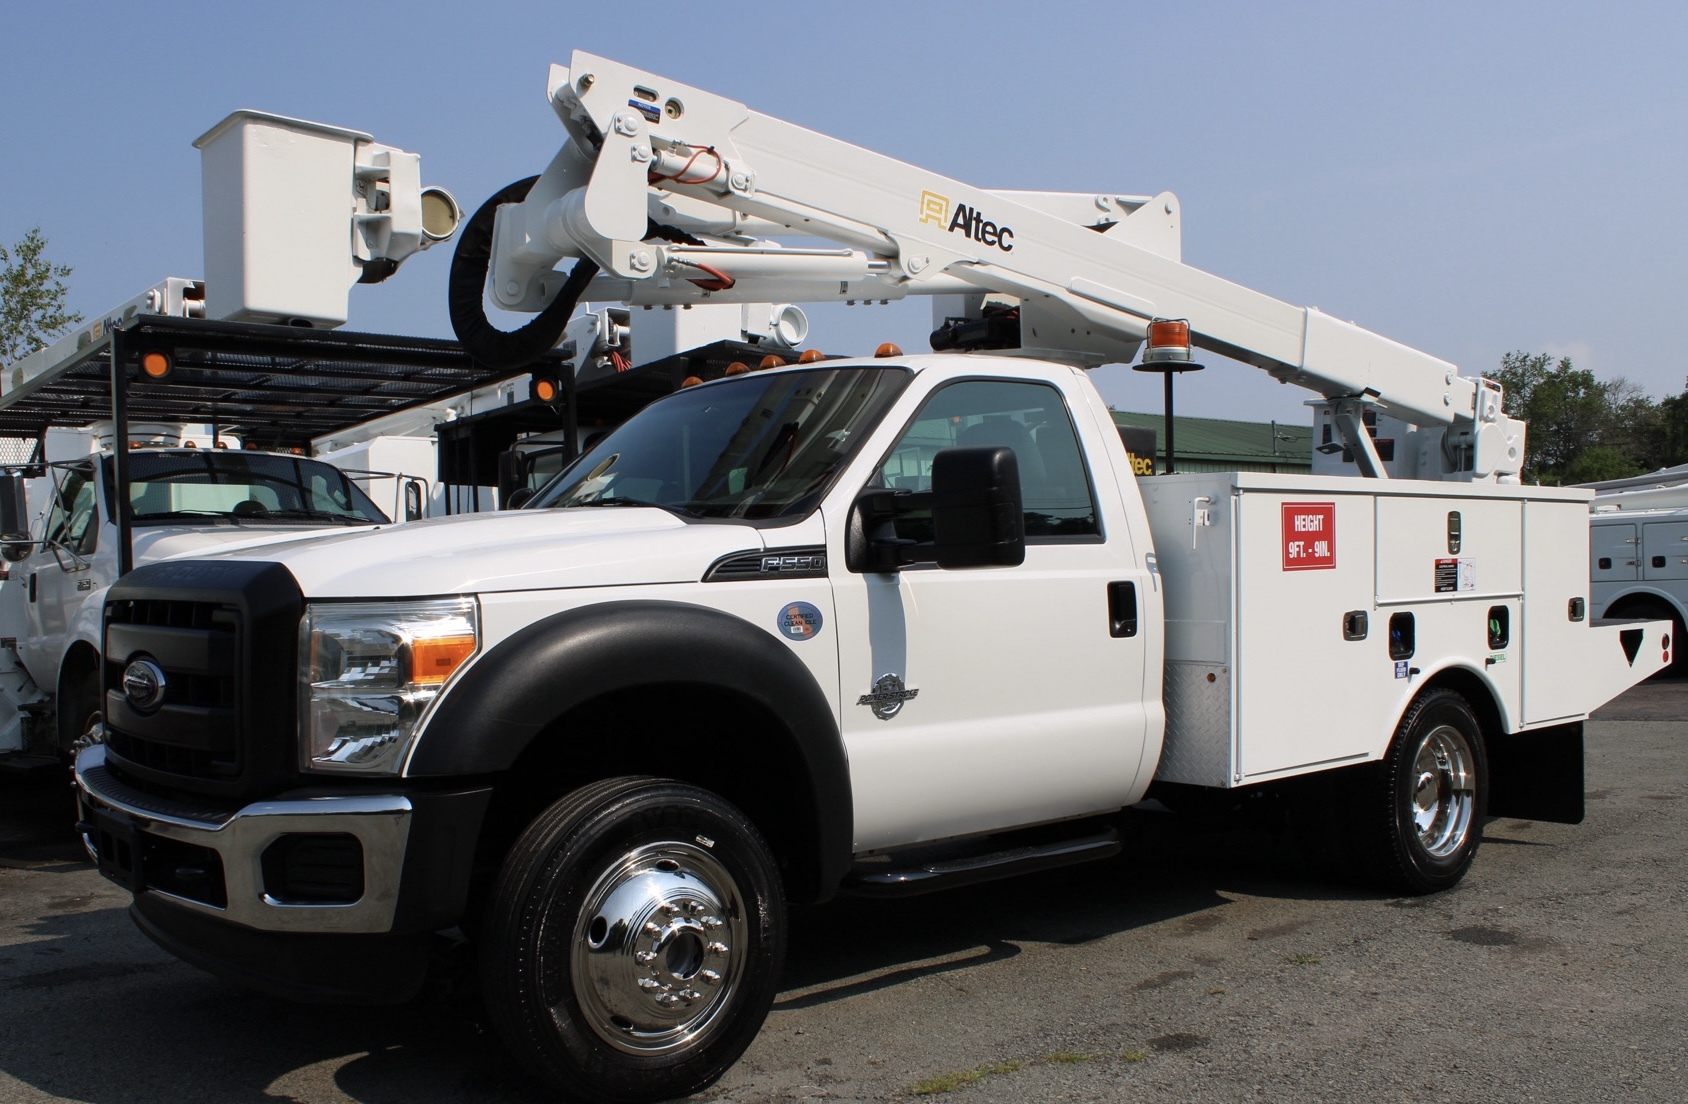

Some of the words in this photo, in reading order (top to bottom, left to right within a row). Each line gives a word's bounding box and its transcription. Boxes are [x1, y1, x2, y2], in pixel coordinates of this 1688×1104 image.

[948, 203, 1014, 252] Altec
[1294, 514, 1324, 532] HEIGHT
[1288, 541, 1306, 558] 9FT.
[1314, 540, 1331, 558] 9IN.
[760, 556, 827, 572] F-550
[785, 612, 814, 620] CERTIFIED
